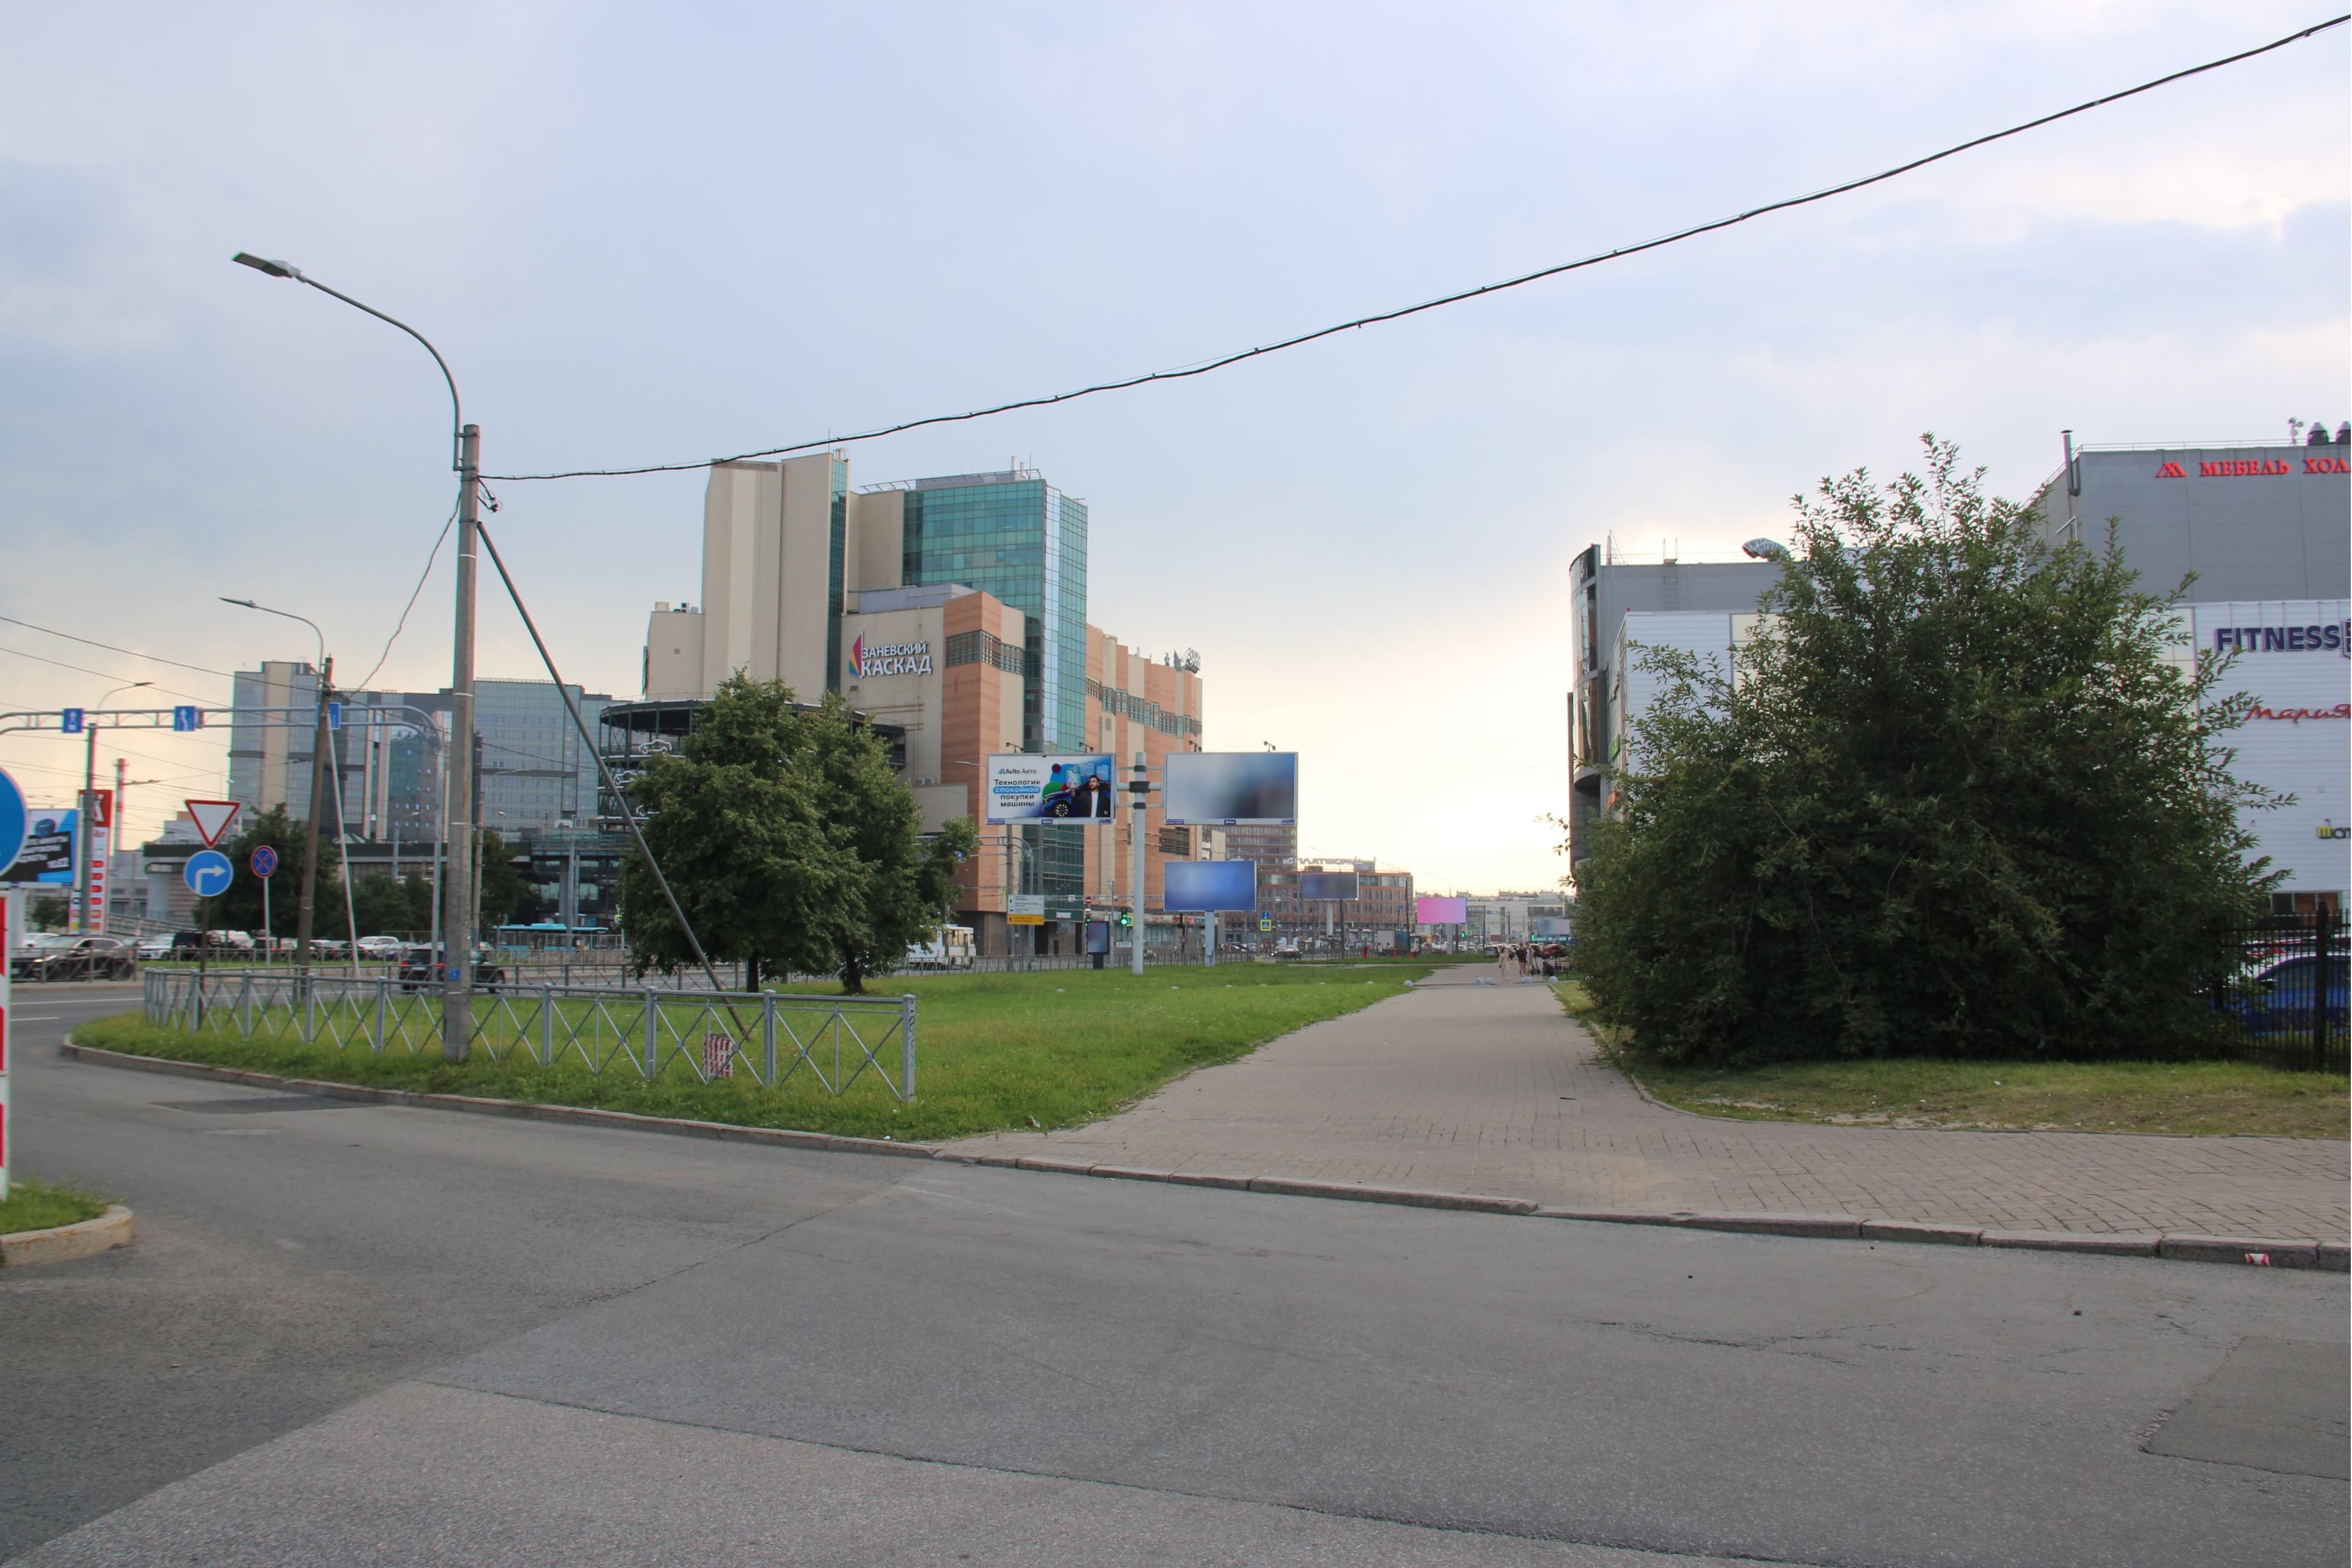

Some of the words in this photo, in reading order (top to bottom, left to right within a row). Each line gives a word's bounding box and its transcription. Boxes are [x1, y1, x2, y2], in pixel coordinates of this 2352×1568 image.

[2199, 459, 2291, 477] МЕБЕЛЬ
[2215, 625, 2340, 651] FITNESS
[862, 640, 927, 659] ЗАНЕВСКИЙ
[862, 655, 932, 677] КАСКАД
